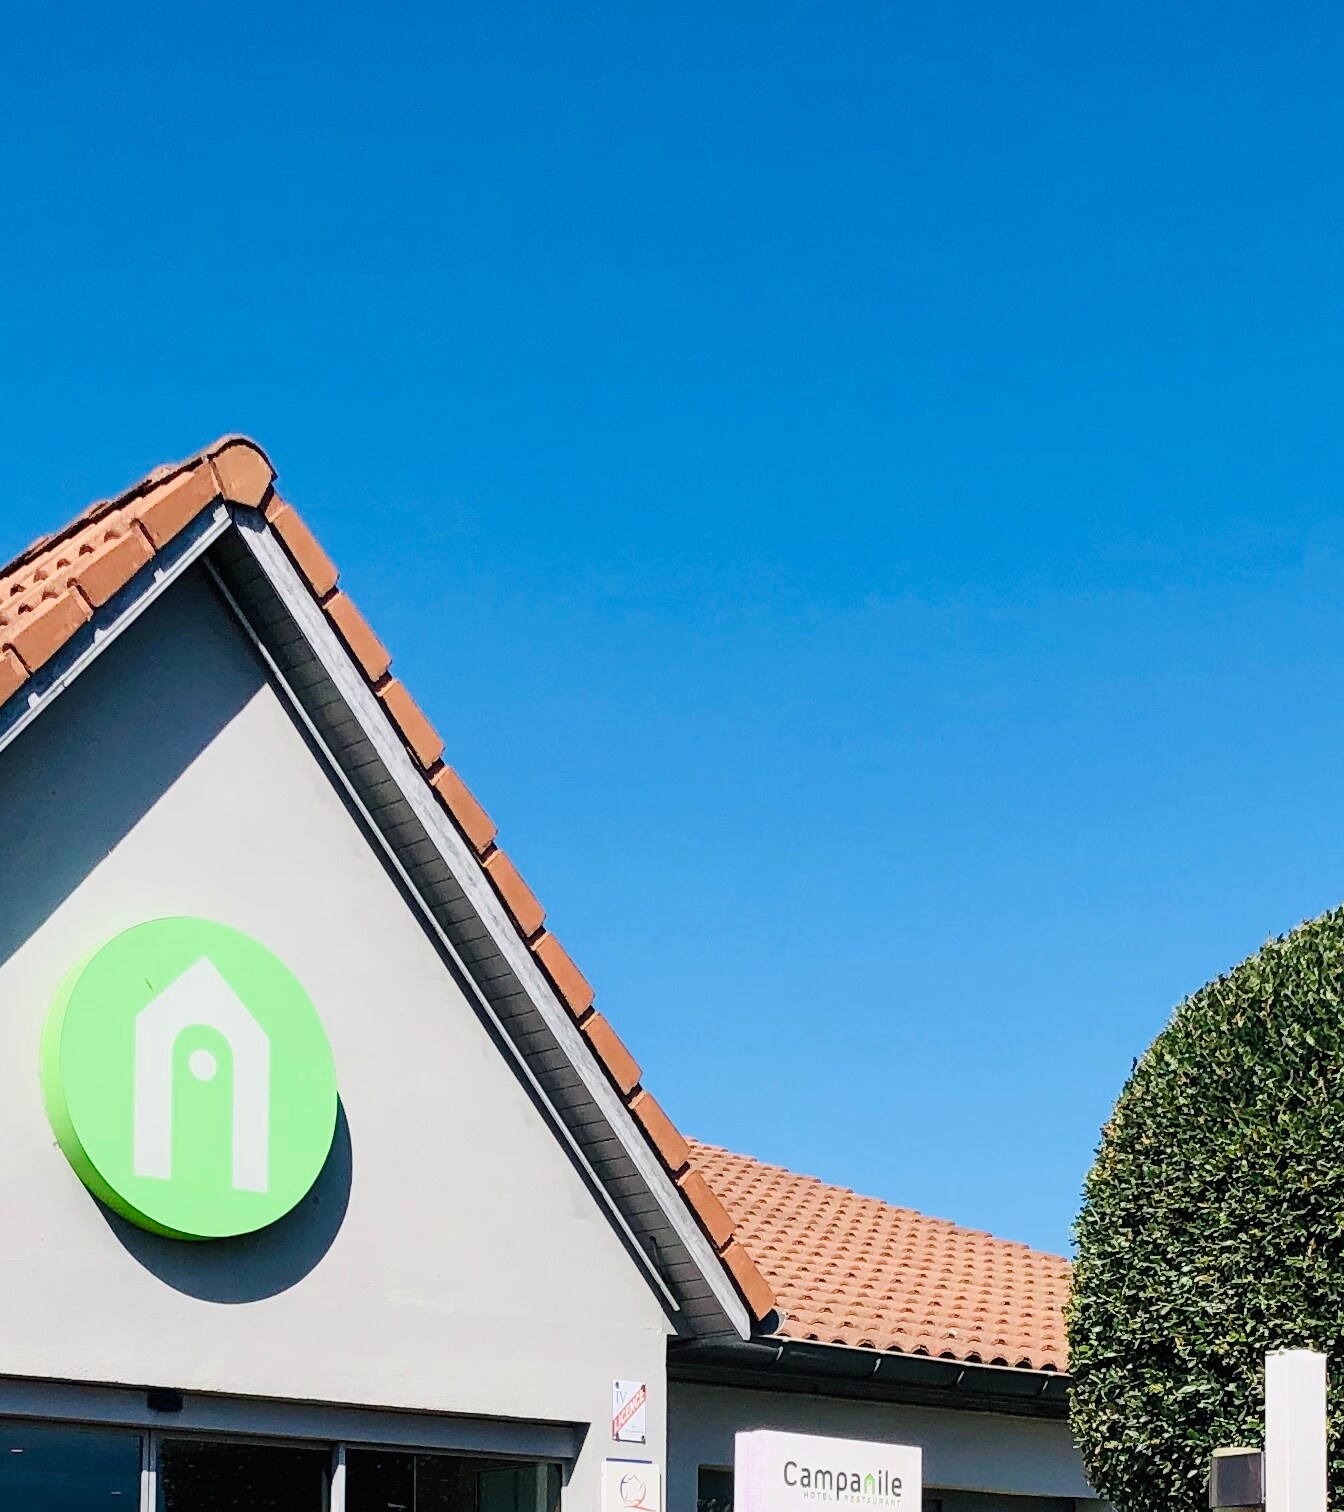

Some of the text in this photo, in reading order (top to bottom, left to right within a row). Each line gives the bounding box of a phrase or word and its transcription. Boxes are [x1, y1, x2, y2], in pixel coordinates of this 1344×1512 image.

[613, 1388, 645, 1437] LICENCE
[783, 1460, 903, 1502] Campanile
[803, 1490, 902, 1508] HOTEL RESTAURANT
